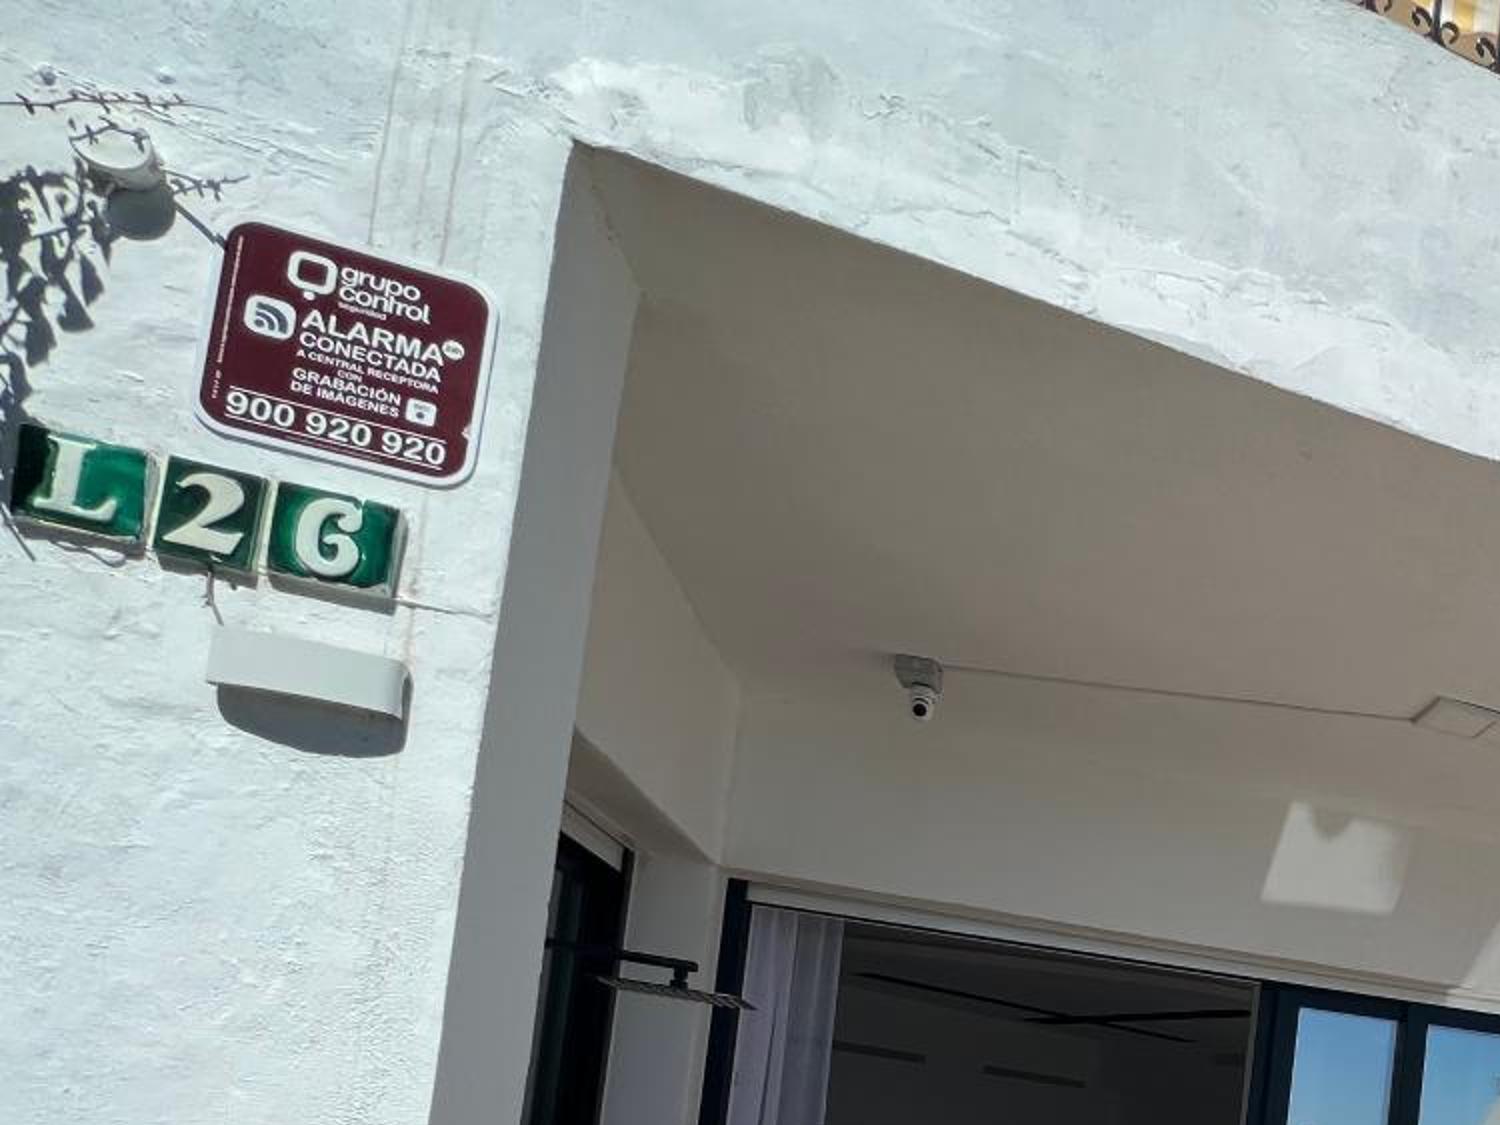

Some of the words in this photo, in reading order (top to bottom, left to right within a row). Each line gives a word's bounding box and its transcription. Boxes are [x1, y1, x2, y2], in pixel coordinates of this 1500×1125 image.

[341, 267, 421, 301] grupo
[339, 286, 430, 325] control
[300, 331, 441, 383] CONECTADA
[302, 309, 444, 366] ALARMA
[292, 367, 401, 406] GRABACIÓN
[296, 349, 305, 359] A
[308, 351, 364, 375] CENTRAL
[367, 367, 438, 394] RECEPTORA
[337, 369, 362, 382] CON
[290, 380, 312, 395] DE
[317, 387, 399, 418] IMAGENES
[226, 391, 295, 427] 900
[305, 411, 371, 447] 920
[381, 431, 446, 465] 920
